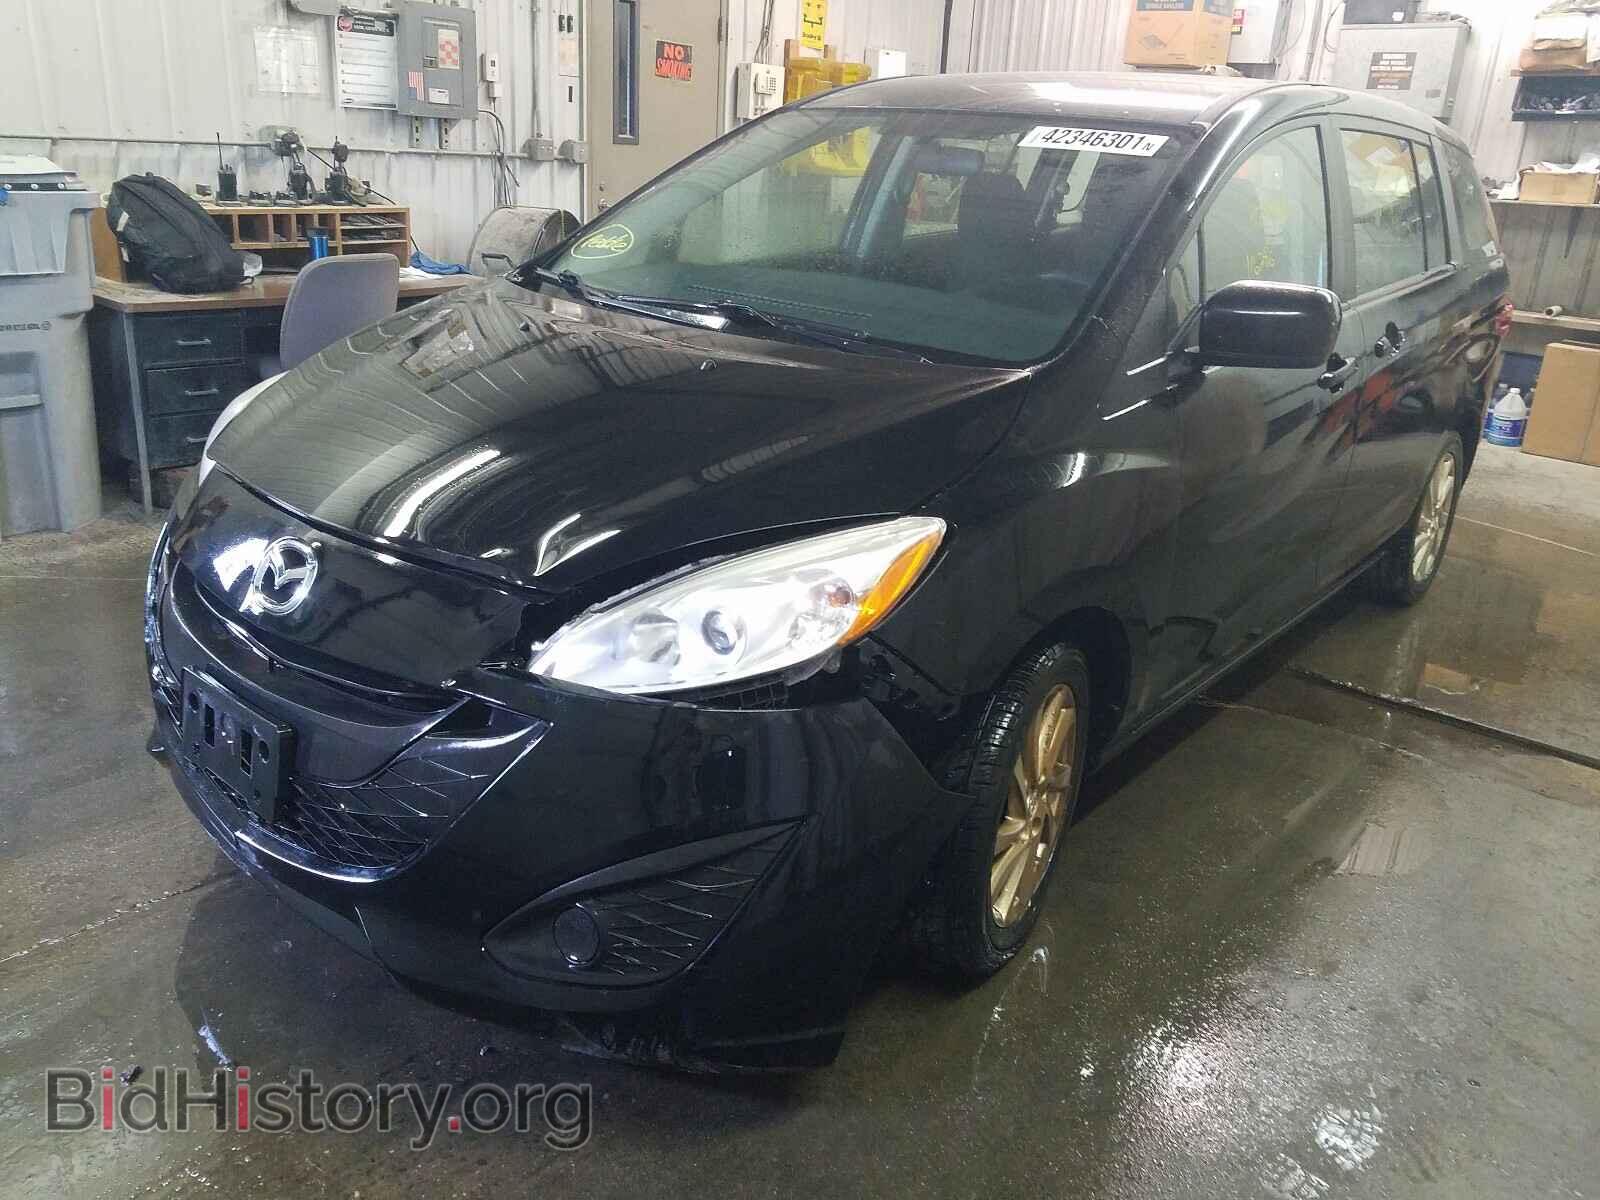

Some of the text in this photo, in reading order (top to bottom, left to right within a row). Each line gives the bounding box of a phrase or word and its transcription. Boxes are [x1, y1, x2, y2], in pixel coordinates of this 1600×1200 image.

[663, 44, 684, 60] NO
[656, 57, 692, 80] SMOKING
[1041, 128, 1146, 150] 42346301
